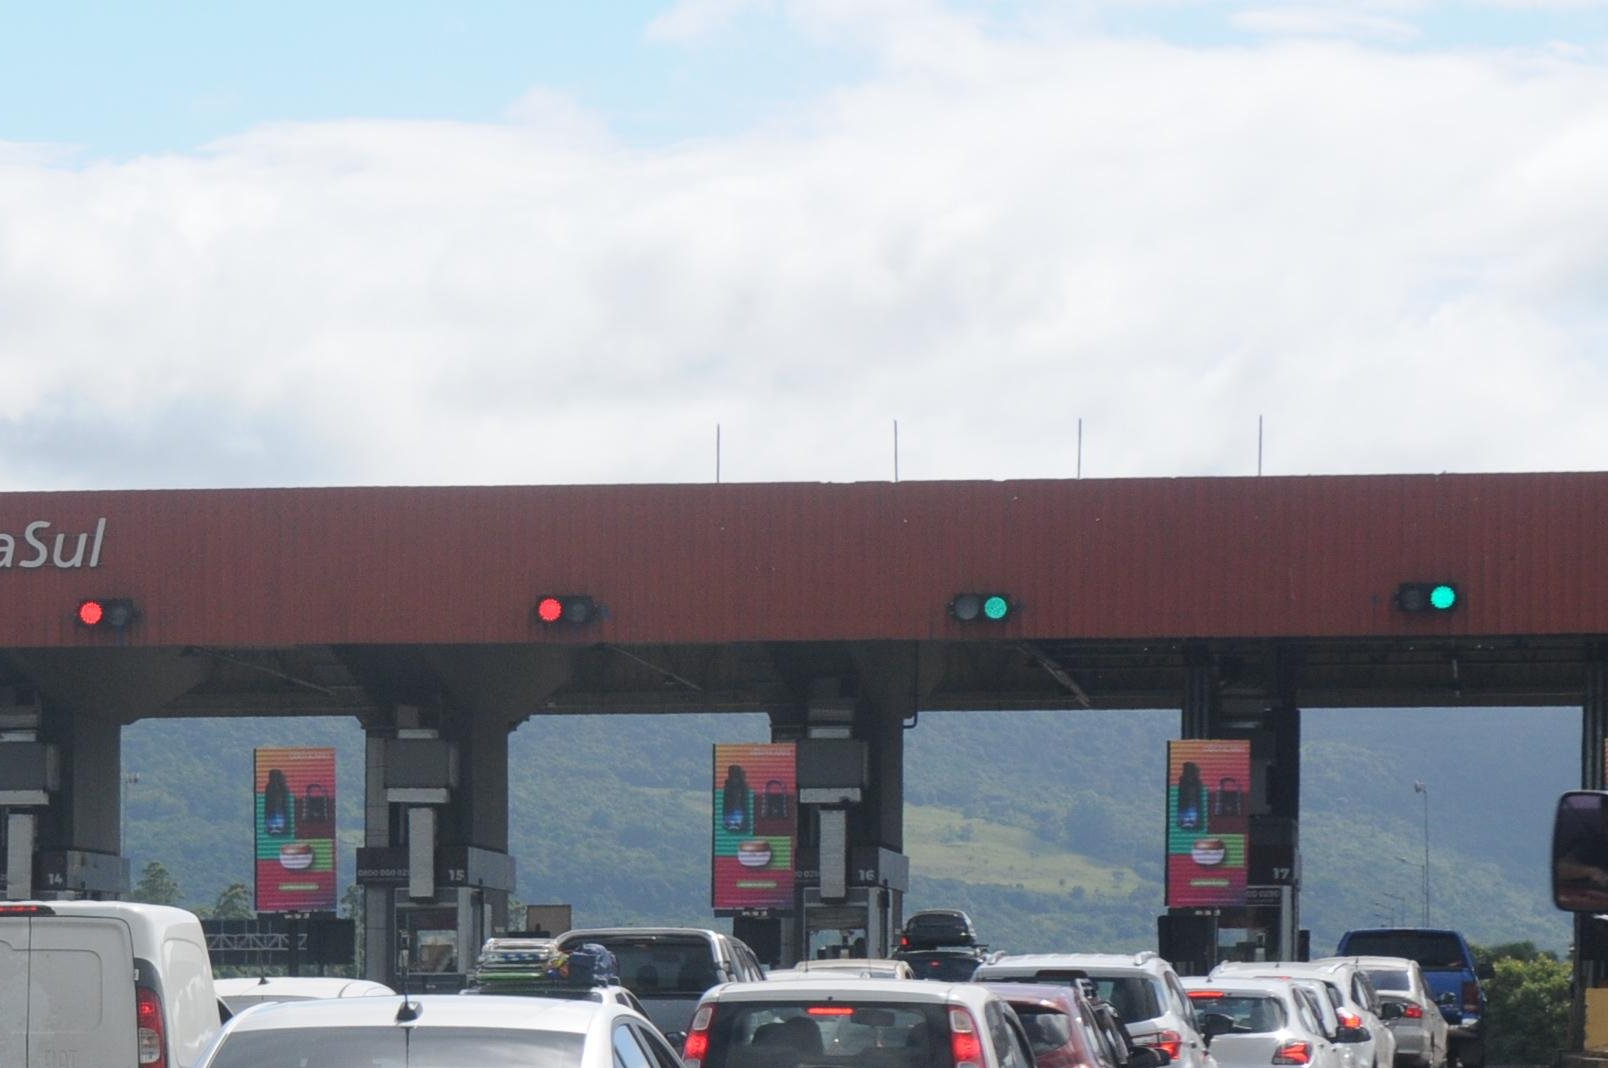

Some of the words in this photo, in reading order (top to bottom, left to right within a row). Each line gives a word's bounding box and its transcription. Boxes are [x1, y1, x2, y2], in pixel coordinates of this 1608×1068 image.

[48, 873, 63, 885] 14
[448, 869, 465, 881] 15
[858, 869, 875, 881] 16
[1273, 868, 1290, 879] 17
